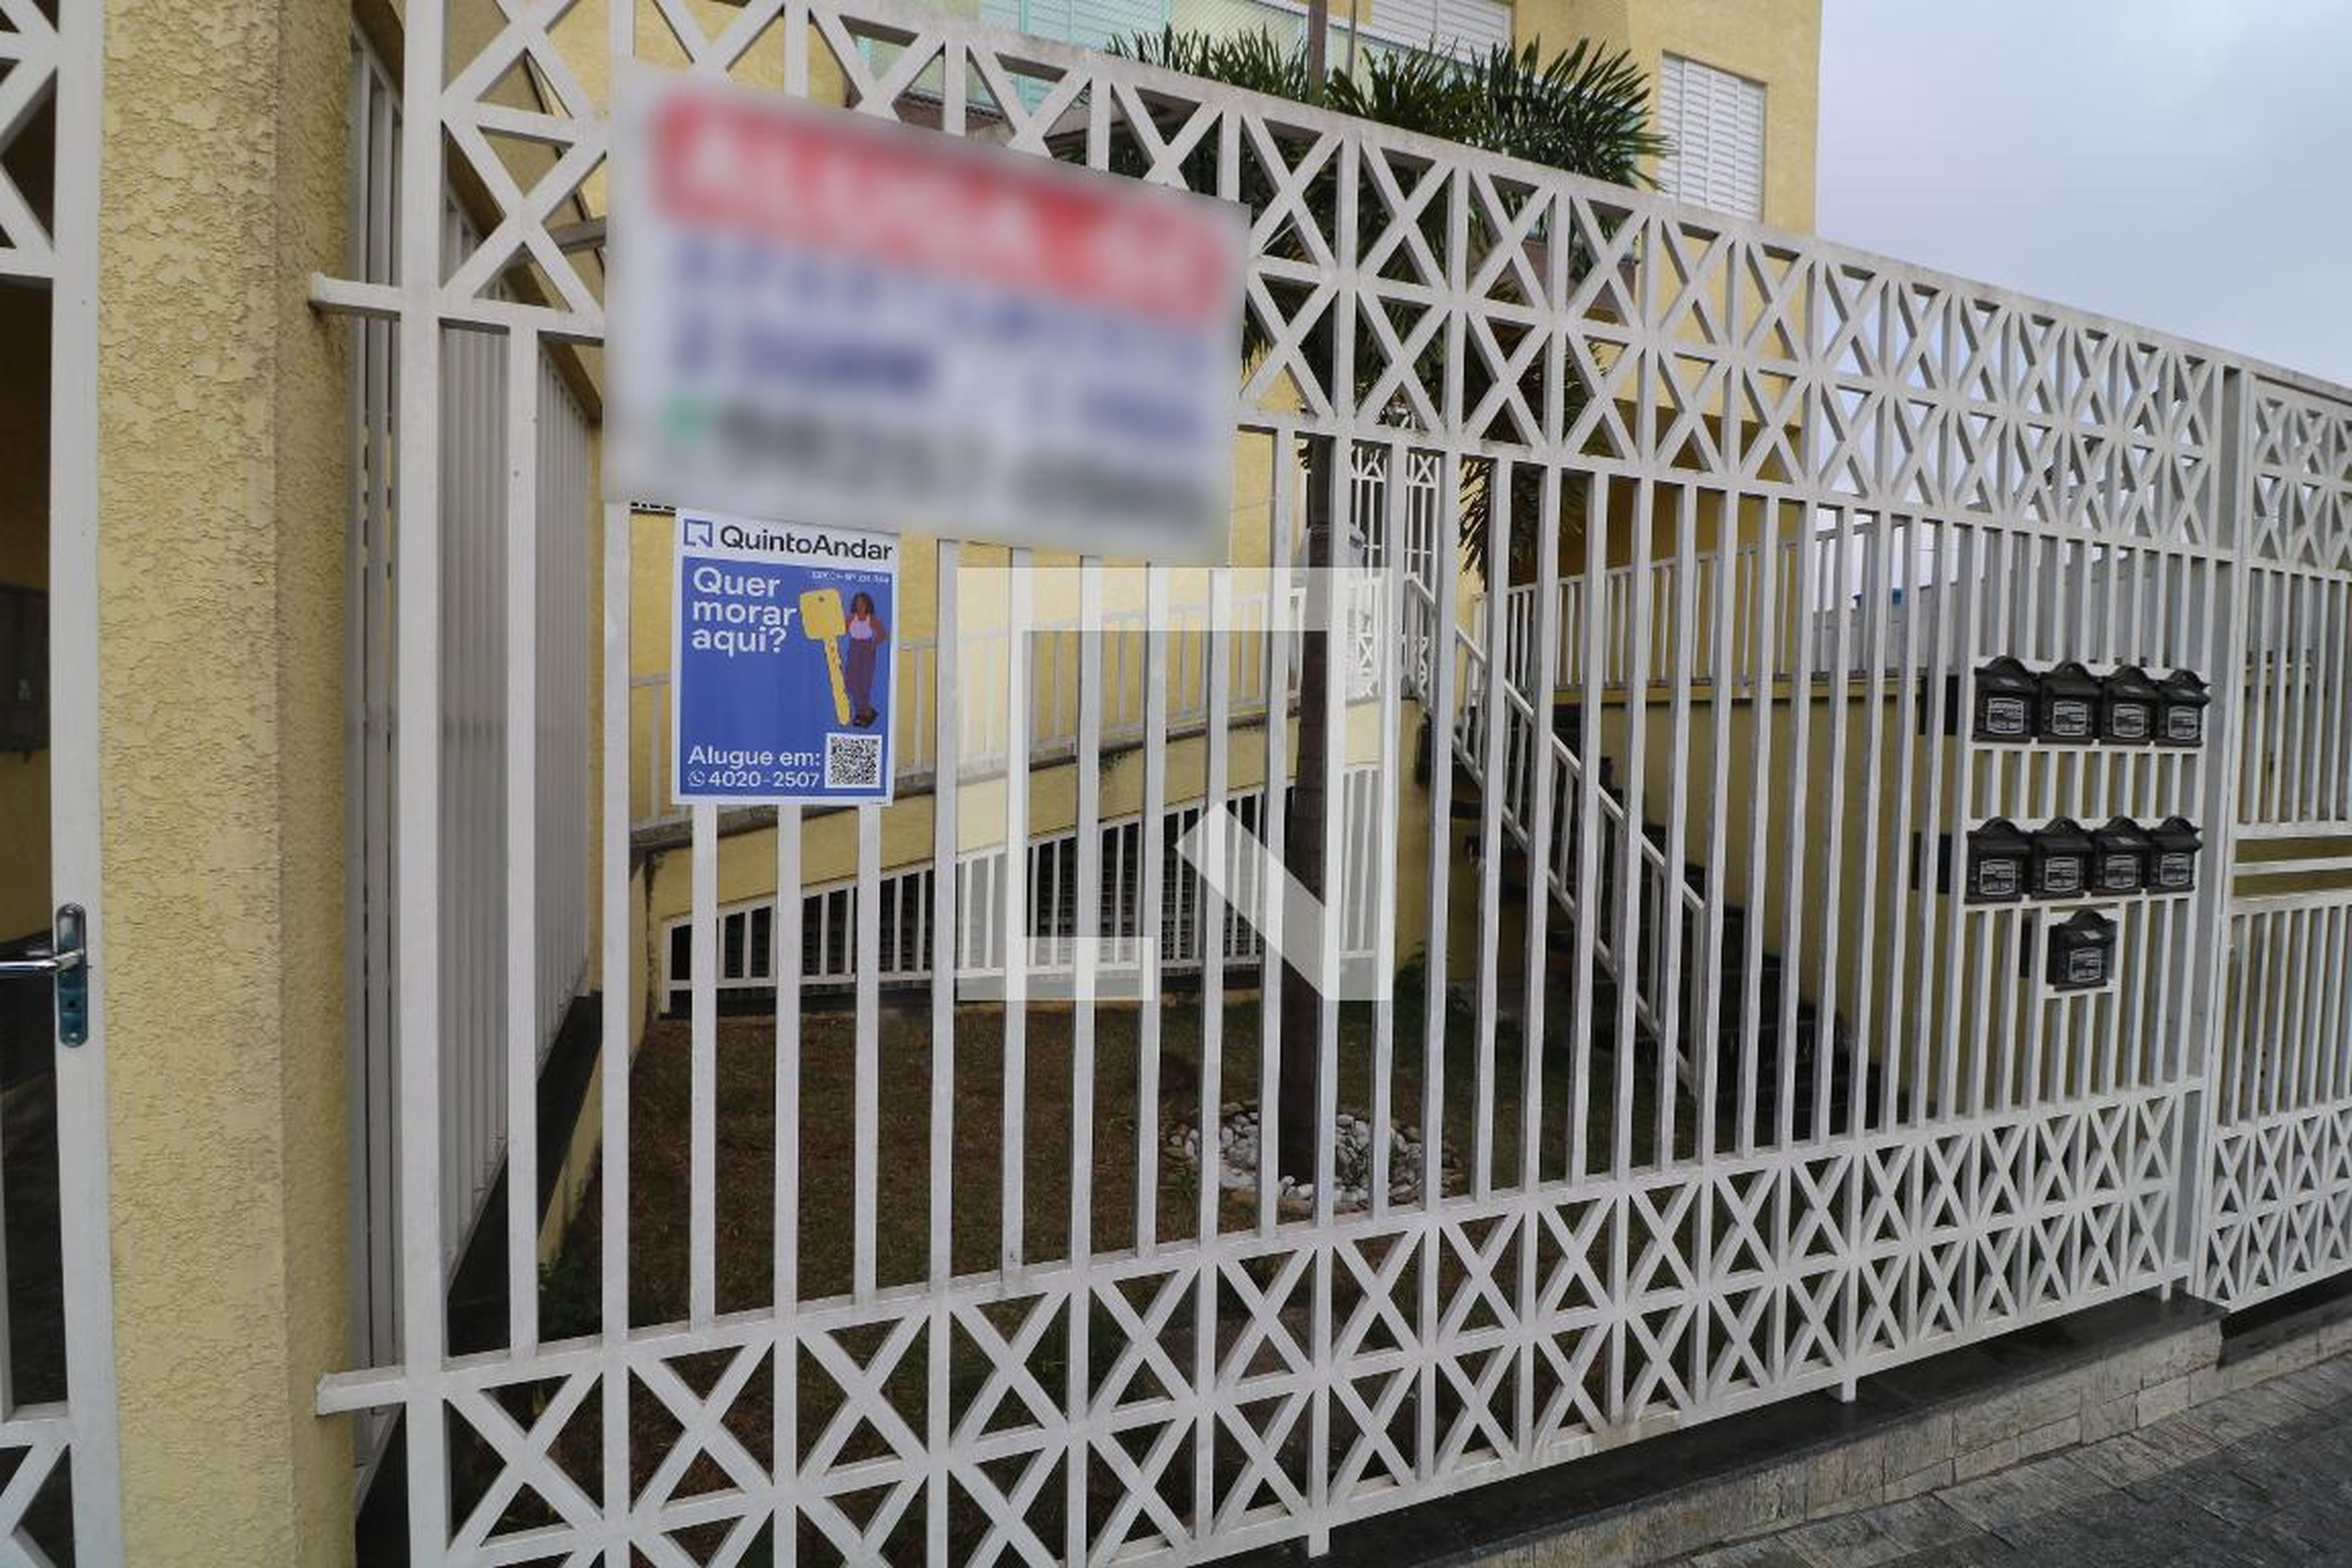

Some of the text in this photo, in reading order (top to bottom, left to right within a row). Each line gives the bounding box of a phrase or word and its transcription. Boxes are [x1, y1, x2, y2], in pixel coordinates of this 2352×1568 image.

[720, 525, 892, 560] QuintoAndar
[693, 567, 780, 597] Quer
[693, 601, 797, 626] morar
[692, 626, 786, 658] aqui?
[687, 745, 821, 769] Alugue em:
